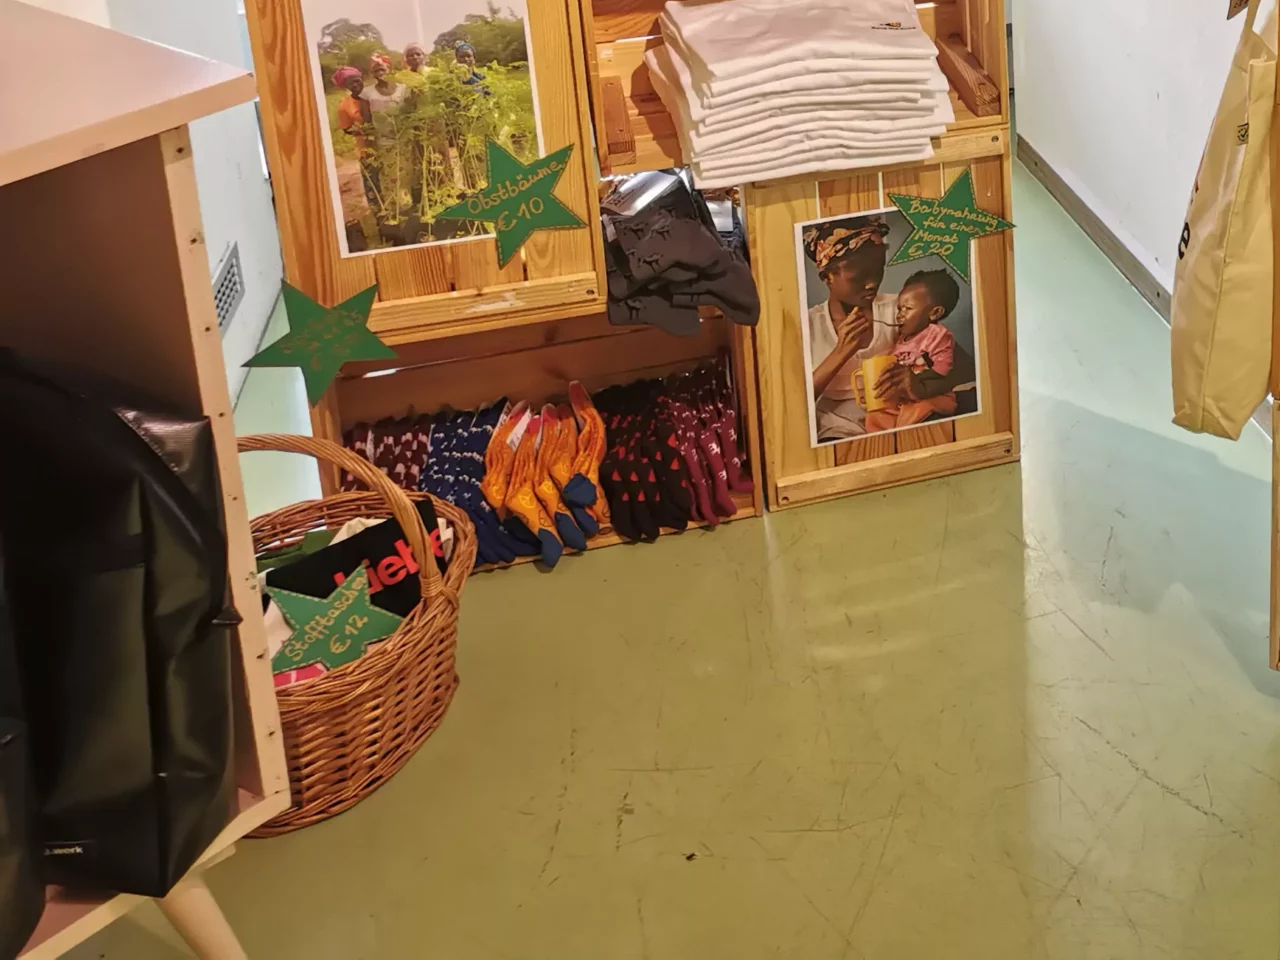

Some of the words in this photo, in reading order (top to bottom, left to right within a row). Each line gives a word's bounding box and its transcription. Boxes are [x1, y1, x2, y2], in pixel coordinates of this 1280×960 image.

[467, 161, 562, 214] Obstbäume
[908, 200, 998, 231] Babynahrung
[914, 230, 959, 243] Monat
